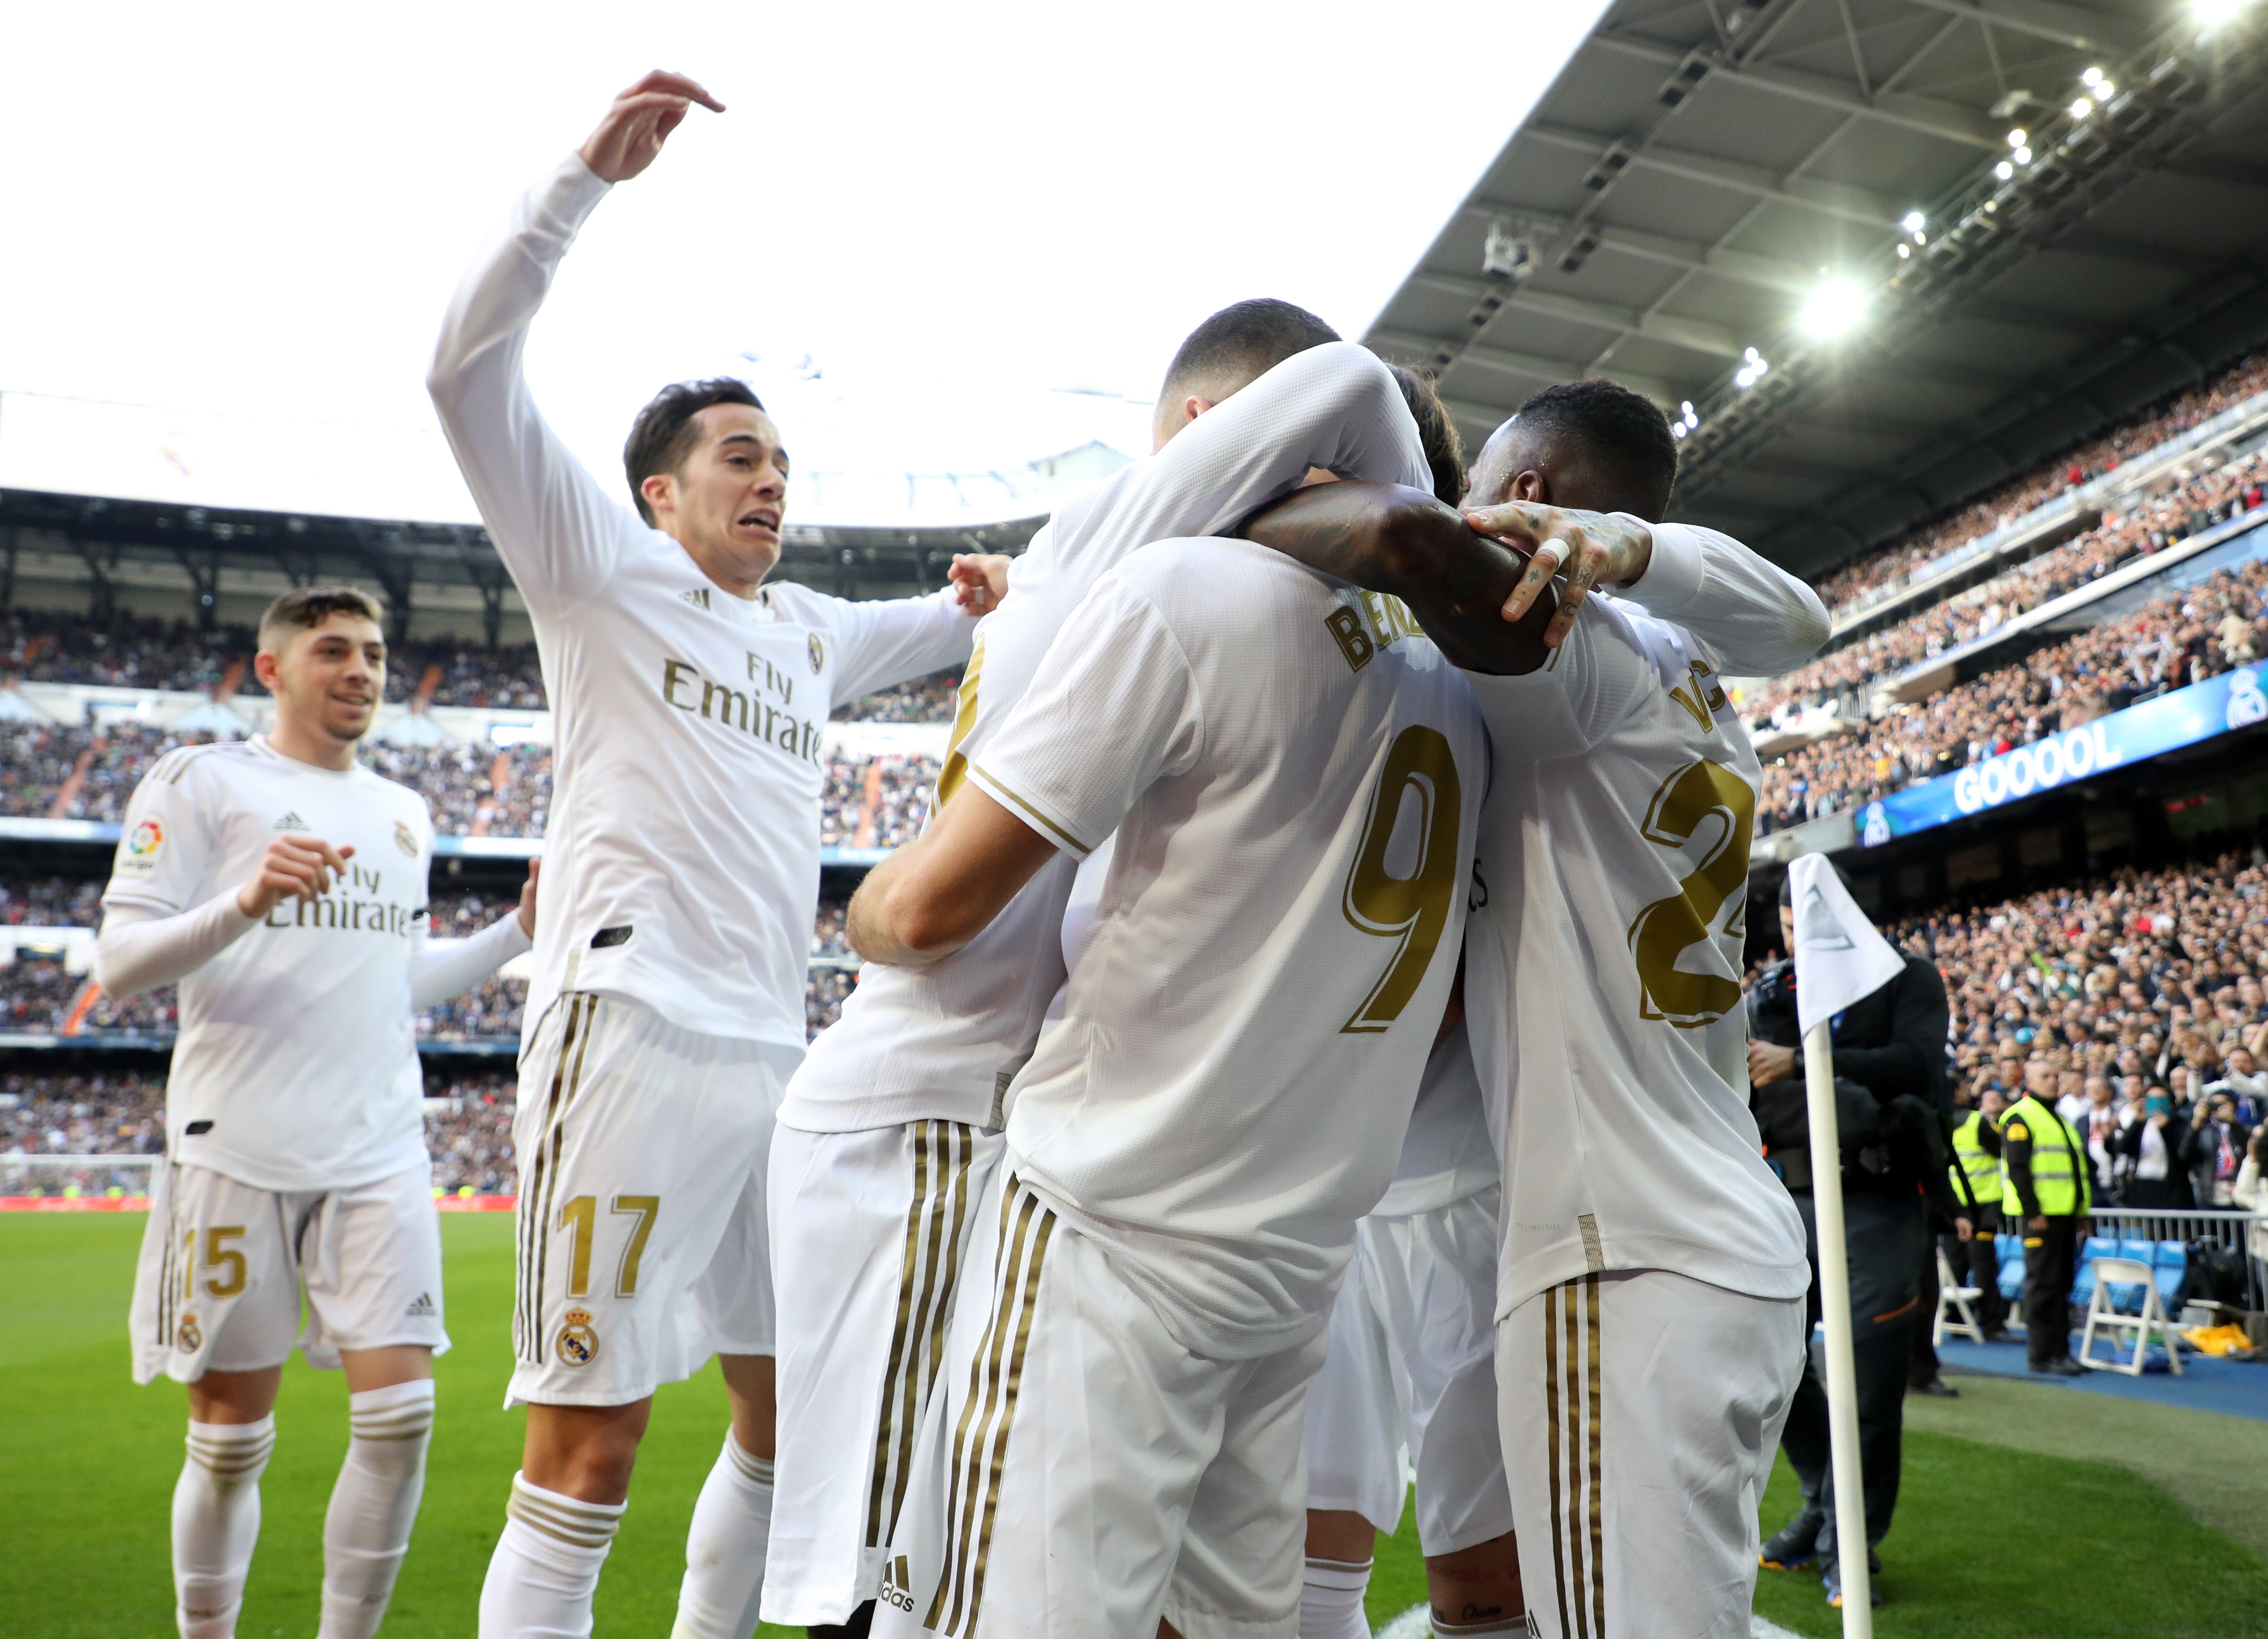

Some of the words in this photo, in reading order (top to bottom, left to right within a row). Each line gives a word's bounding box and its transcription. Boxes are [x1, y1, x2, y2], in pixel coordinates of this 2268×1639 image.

[747, 650, 793, 705] Fly
[1954, 721, 2122, 814] GOOOOL
[1339, 725, 1461, 1033] 9
[1628, 758, 1755, 1029] 2
[183, 1224, 247, 1301] 15
[557, 1195, 660, 1299] 17
